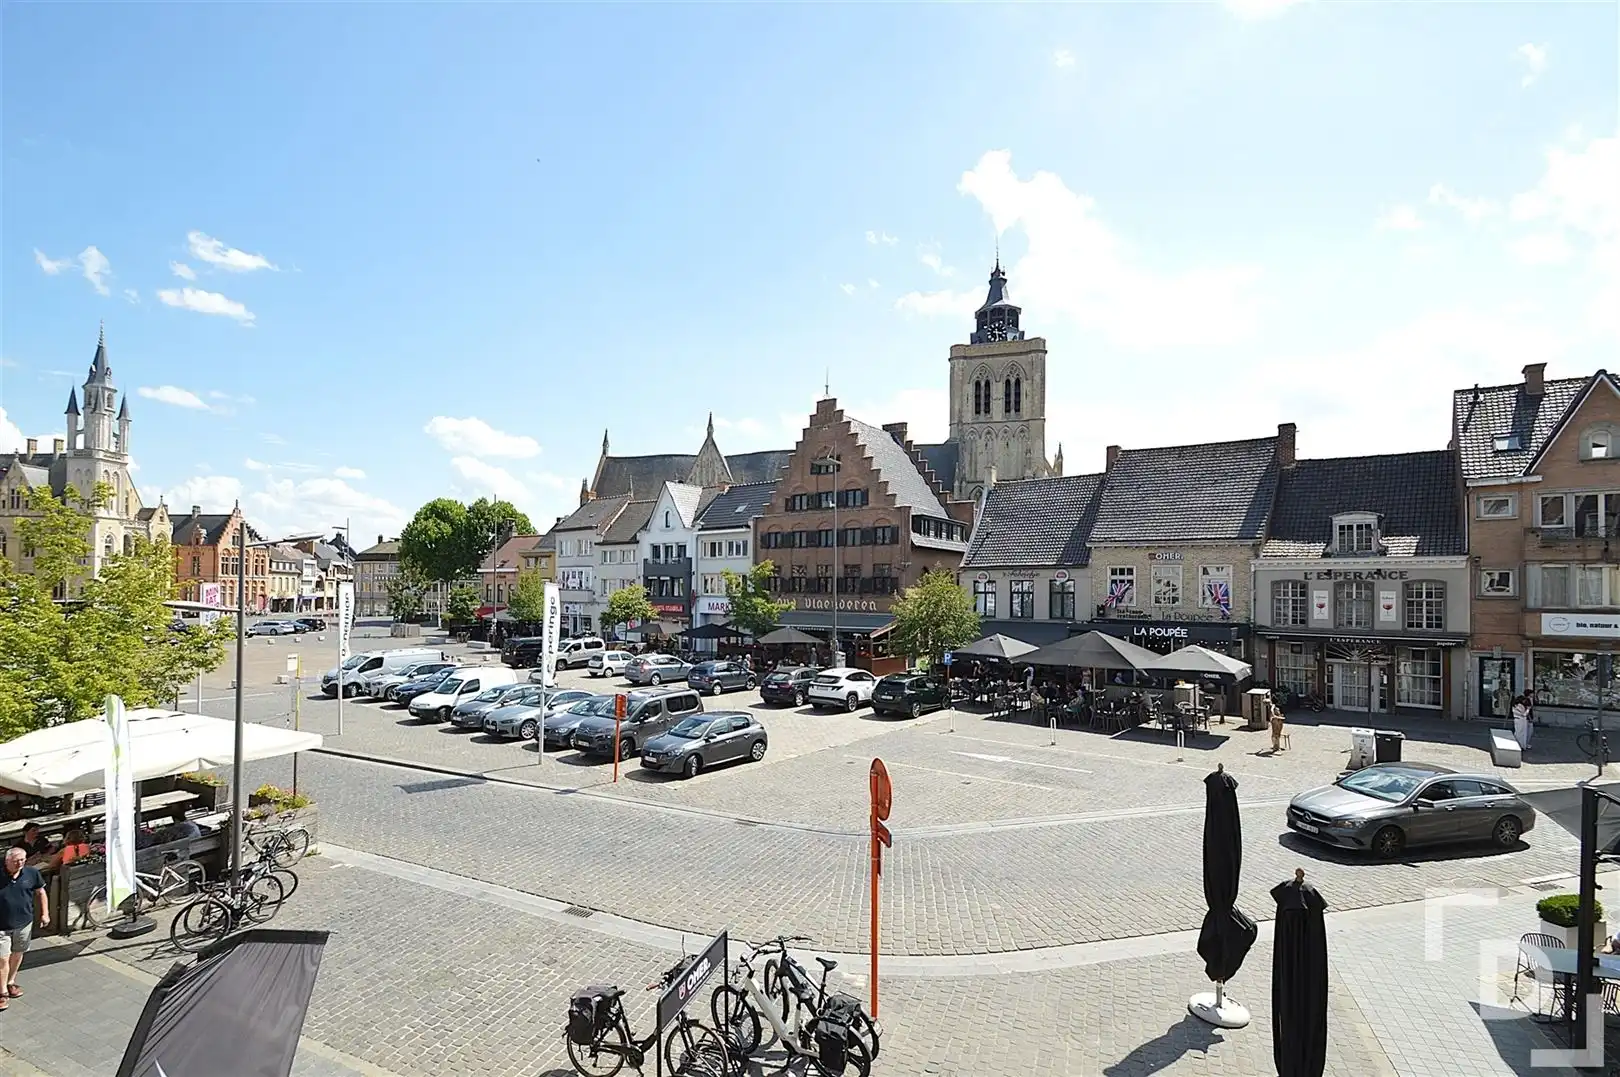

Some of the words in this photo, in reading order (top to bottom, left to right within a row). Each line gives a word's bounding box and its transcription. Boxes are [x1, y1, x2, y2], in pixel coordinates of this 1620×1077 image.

[707, 602, 733, 612] MARK
[1133, 627, 1147, 636] LA
[1149, 626, 1189, 638] POUPÉE
